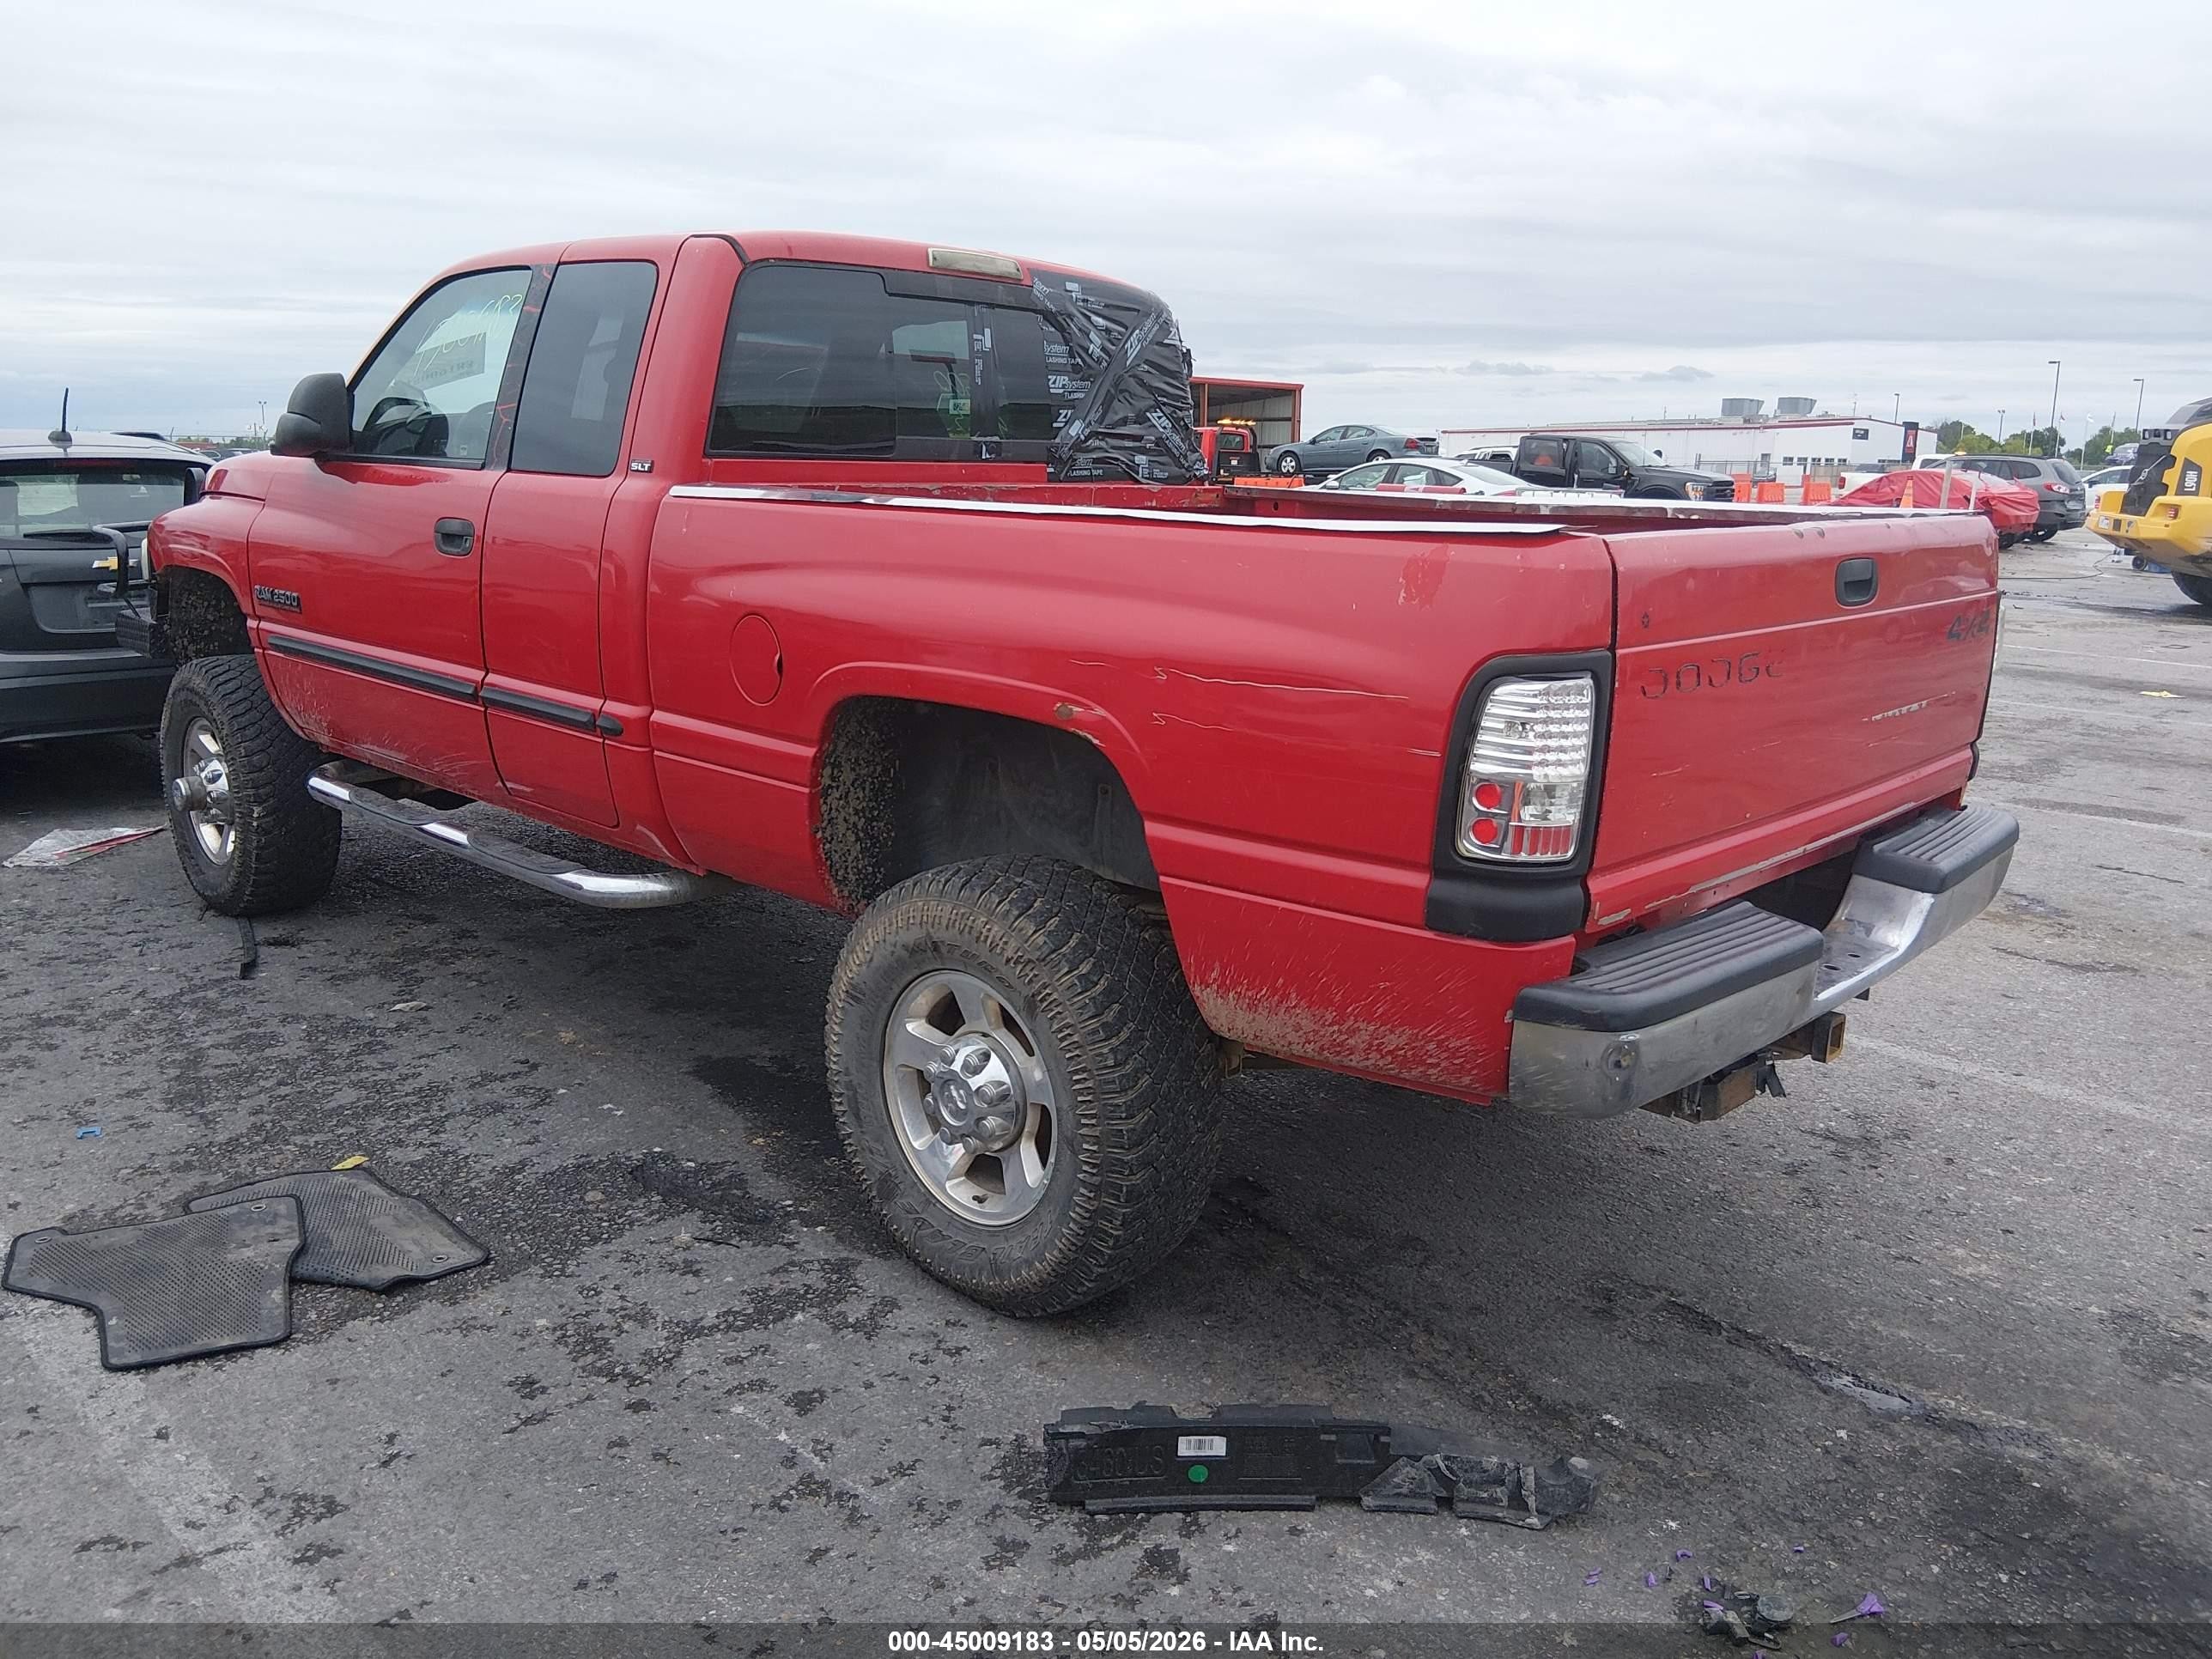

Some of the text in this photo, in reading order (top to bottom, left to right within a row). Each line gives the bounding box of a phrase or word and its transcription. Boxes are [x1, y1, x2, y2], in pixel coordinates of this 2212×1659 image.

[631, 463, 651, 471] SLT
[2184, 471, 2198, 491] L90H
[254, 586, 298, 606] RAM 2500
